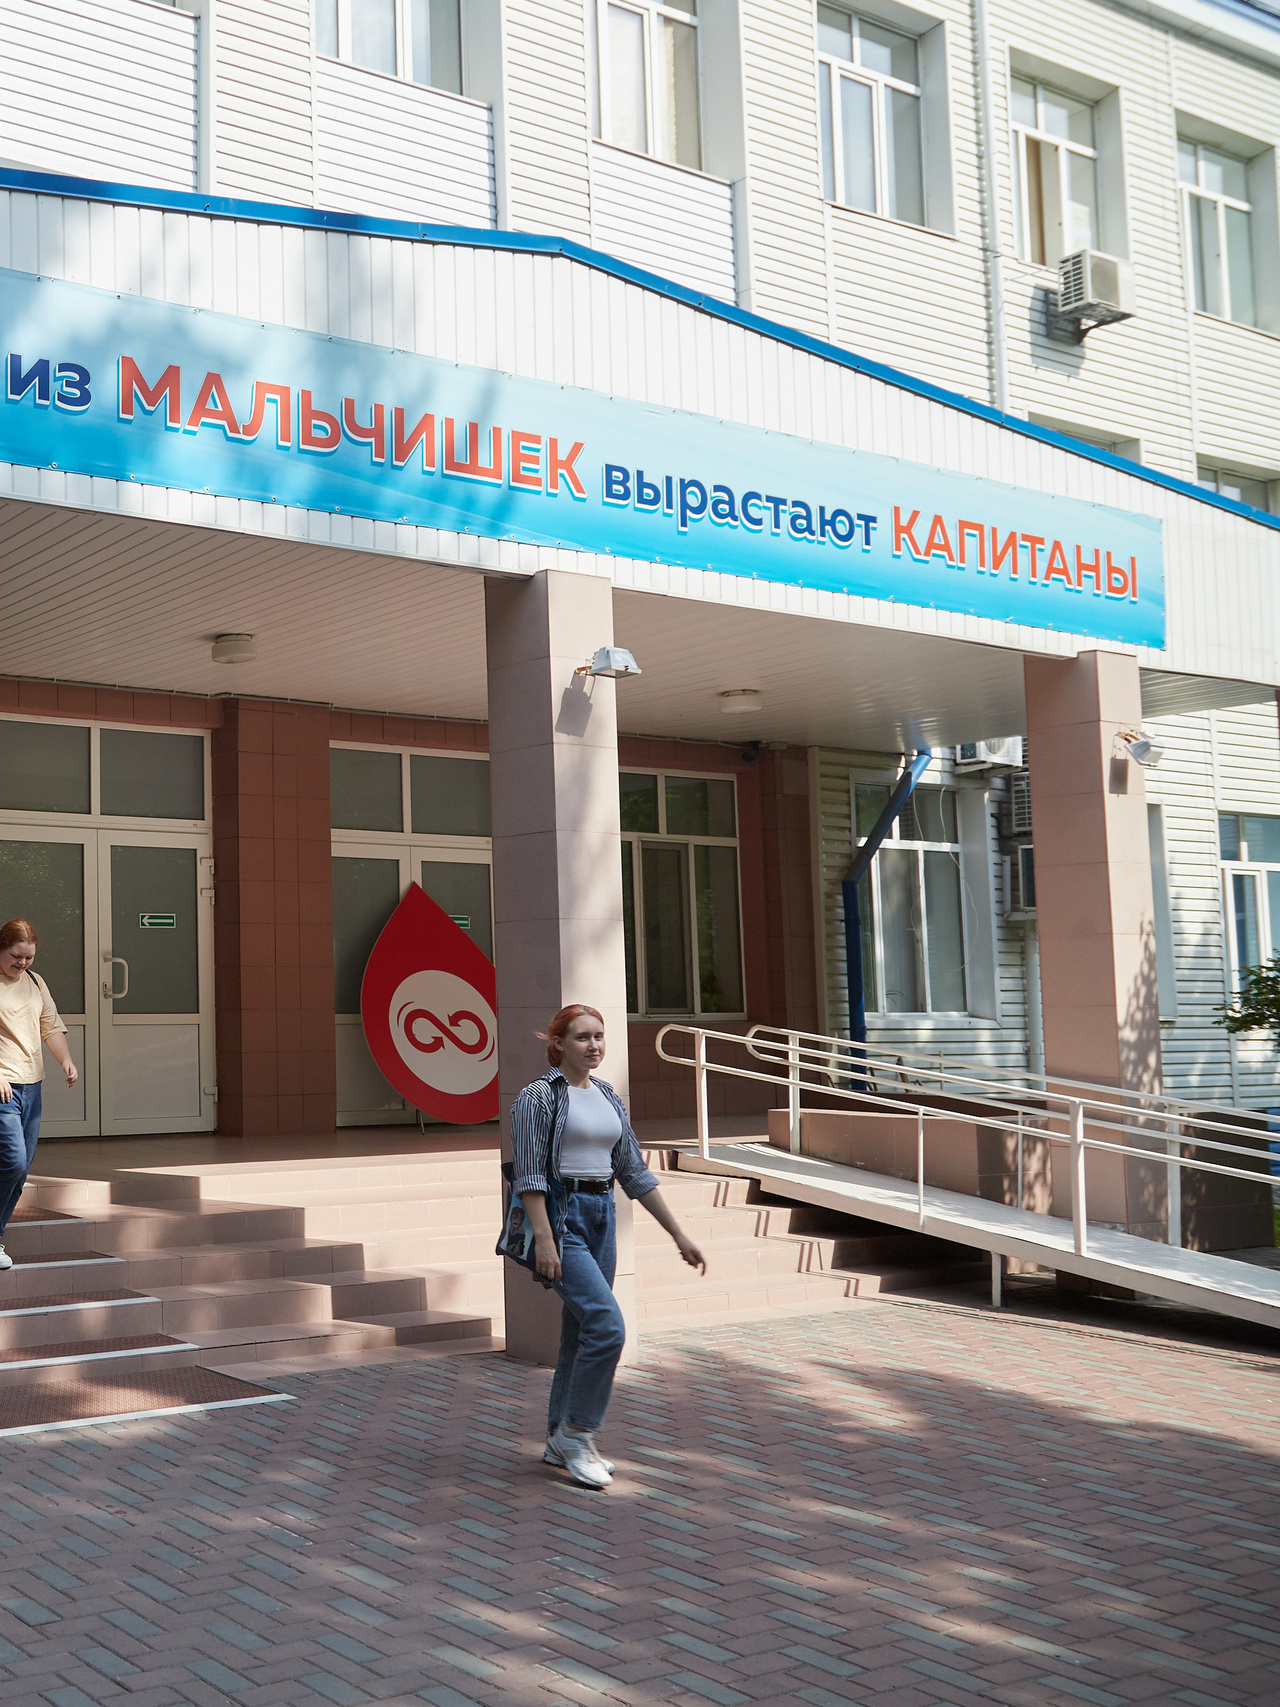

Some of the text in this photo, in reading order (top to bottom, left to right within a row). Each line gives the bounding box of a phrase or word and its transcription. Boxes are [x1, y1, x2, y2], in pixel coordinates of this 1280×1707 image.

[7, 352, 92, 413] из
[119, 355, 587, 500] МАЛЬЧИШЕК
[601, 463, 878, 552] вырастают
[891, 504, 1139, 603] КАПИТАНЫ
